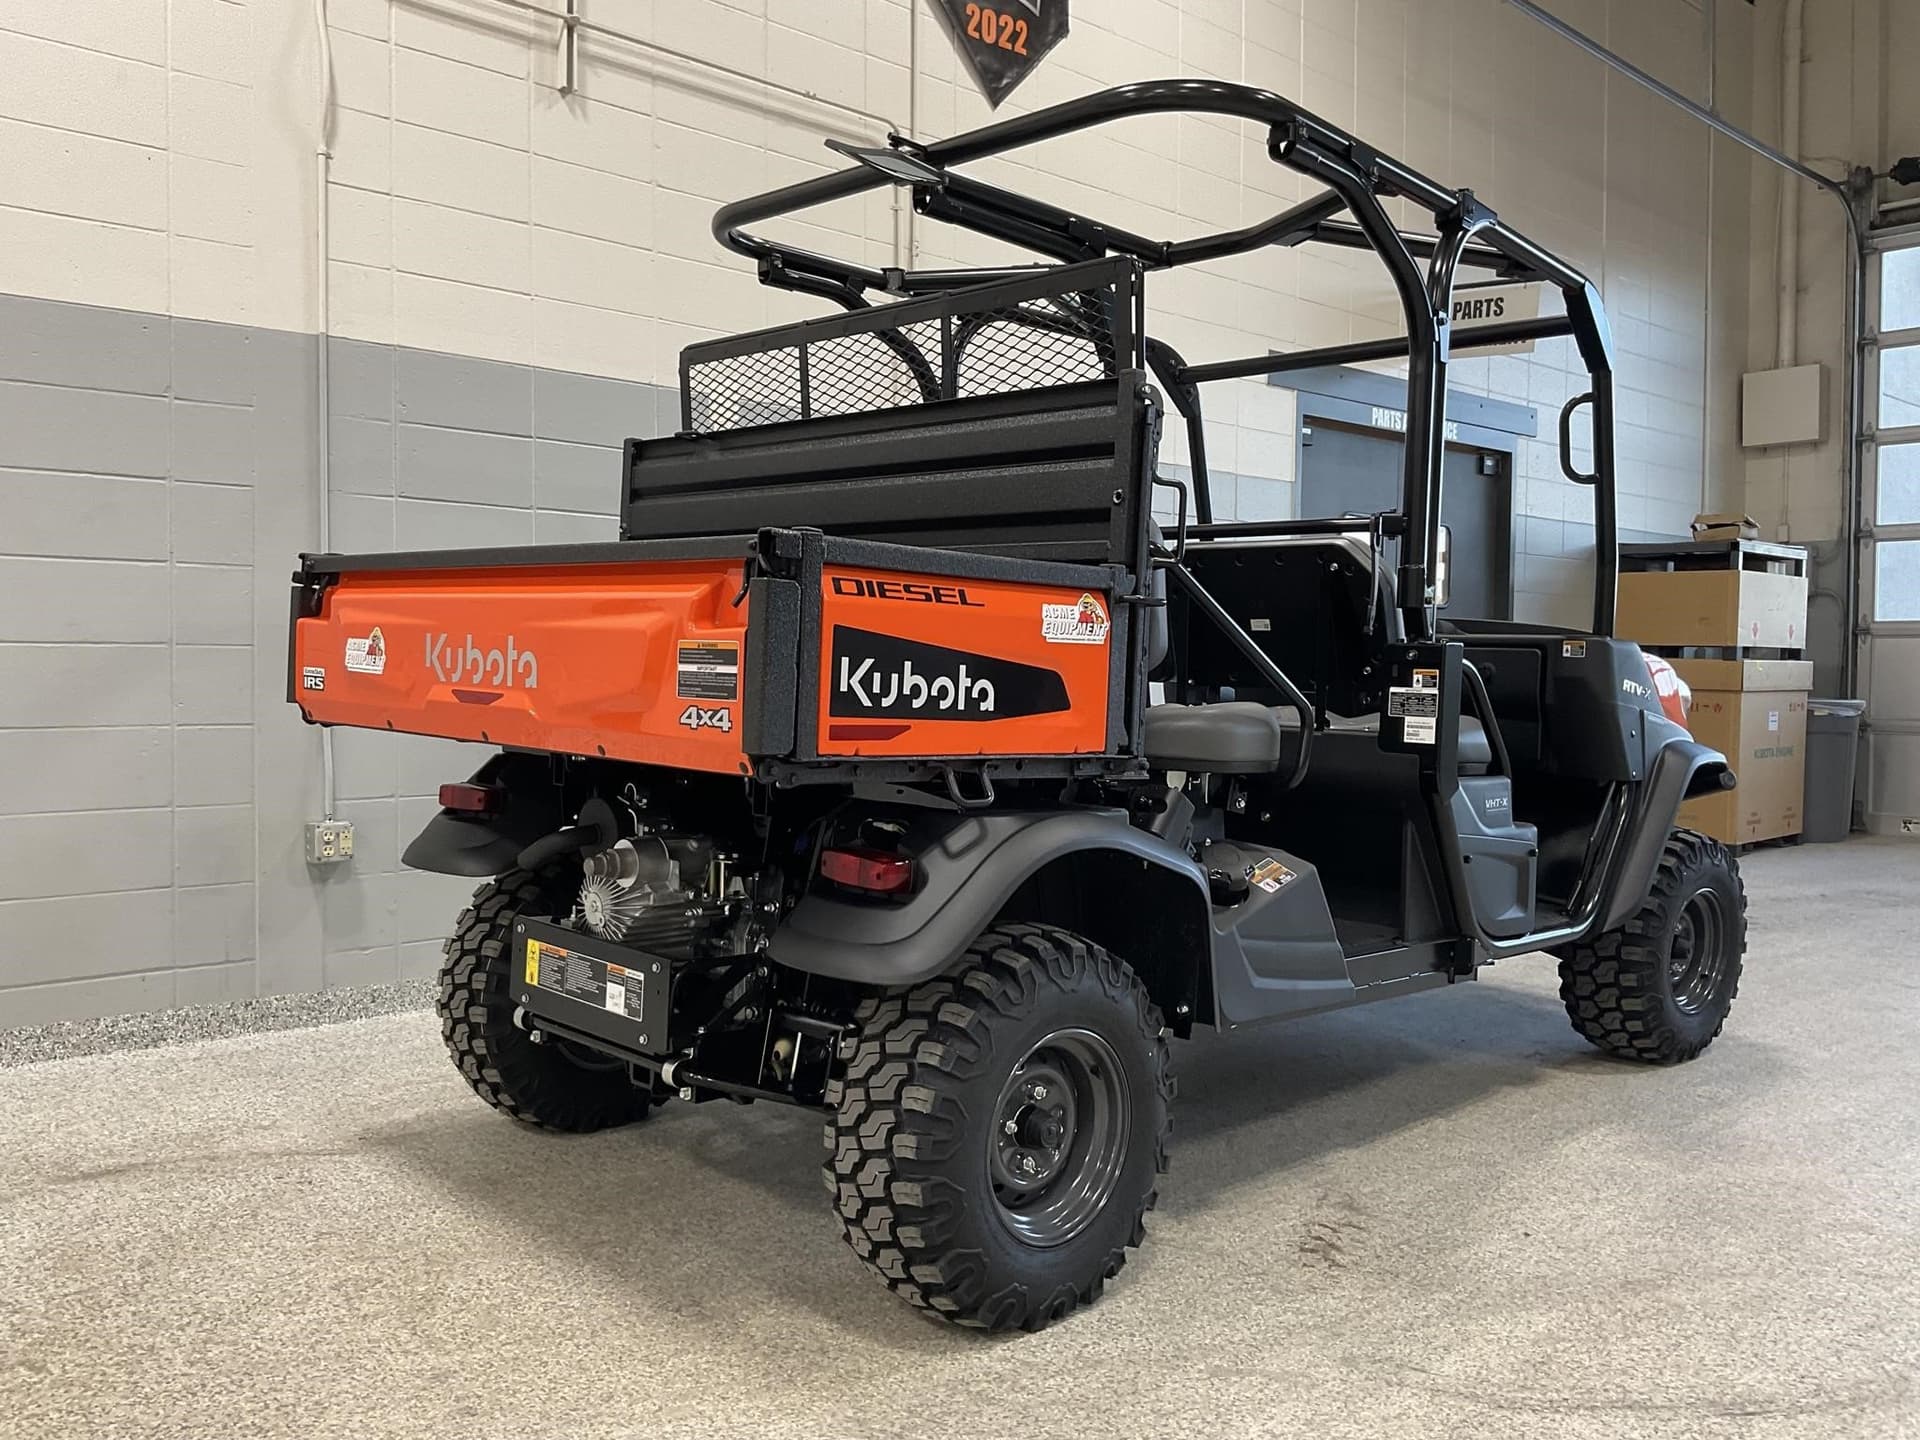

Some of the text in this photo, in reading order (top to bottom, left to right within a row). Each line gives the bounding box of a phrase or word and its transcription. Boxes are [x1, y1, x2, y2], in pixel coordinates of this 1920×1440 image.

[966, 3, 1028, 56] 2022
[1452, 297, 1504, 321] PARTS
[1372, 407, 1401, 430] PARTS
[831, 577, 986, 607] DIESEL
[1044, 606, 1076, 620] ACME
[1044, 619, 1108, 637] EQUIPMENT
[425, 633, 538, 689] Kubota
[304, 676, 324, 690] IRS
[839, 656, 995, 712] Kubota
